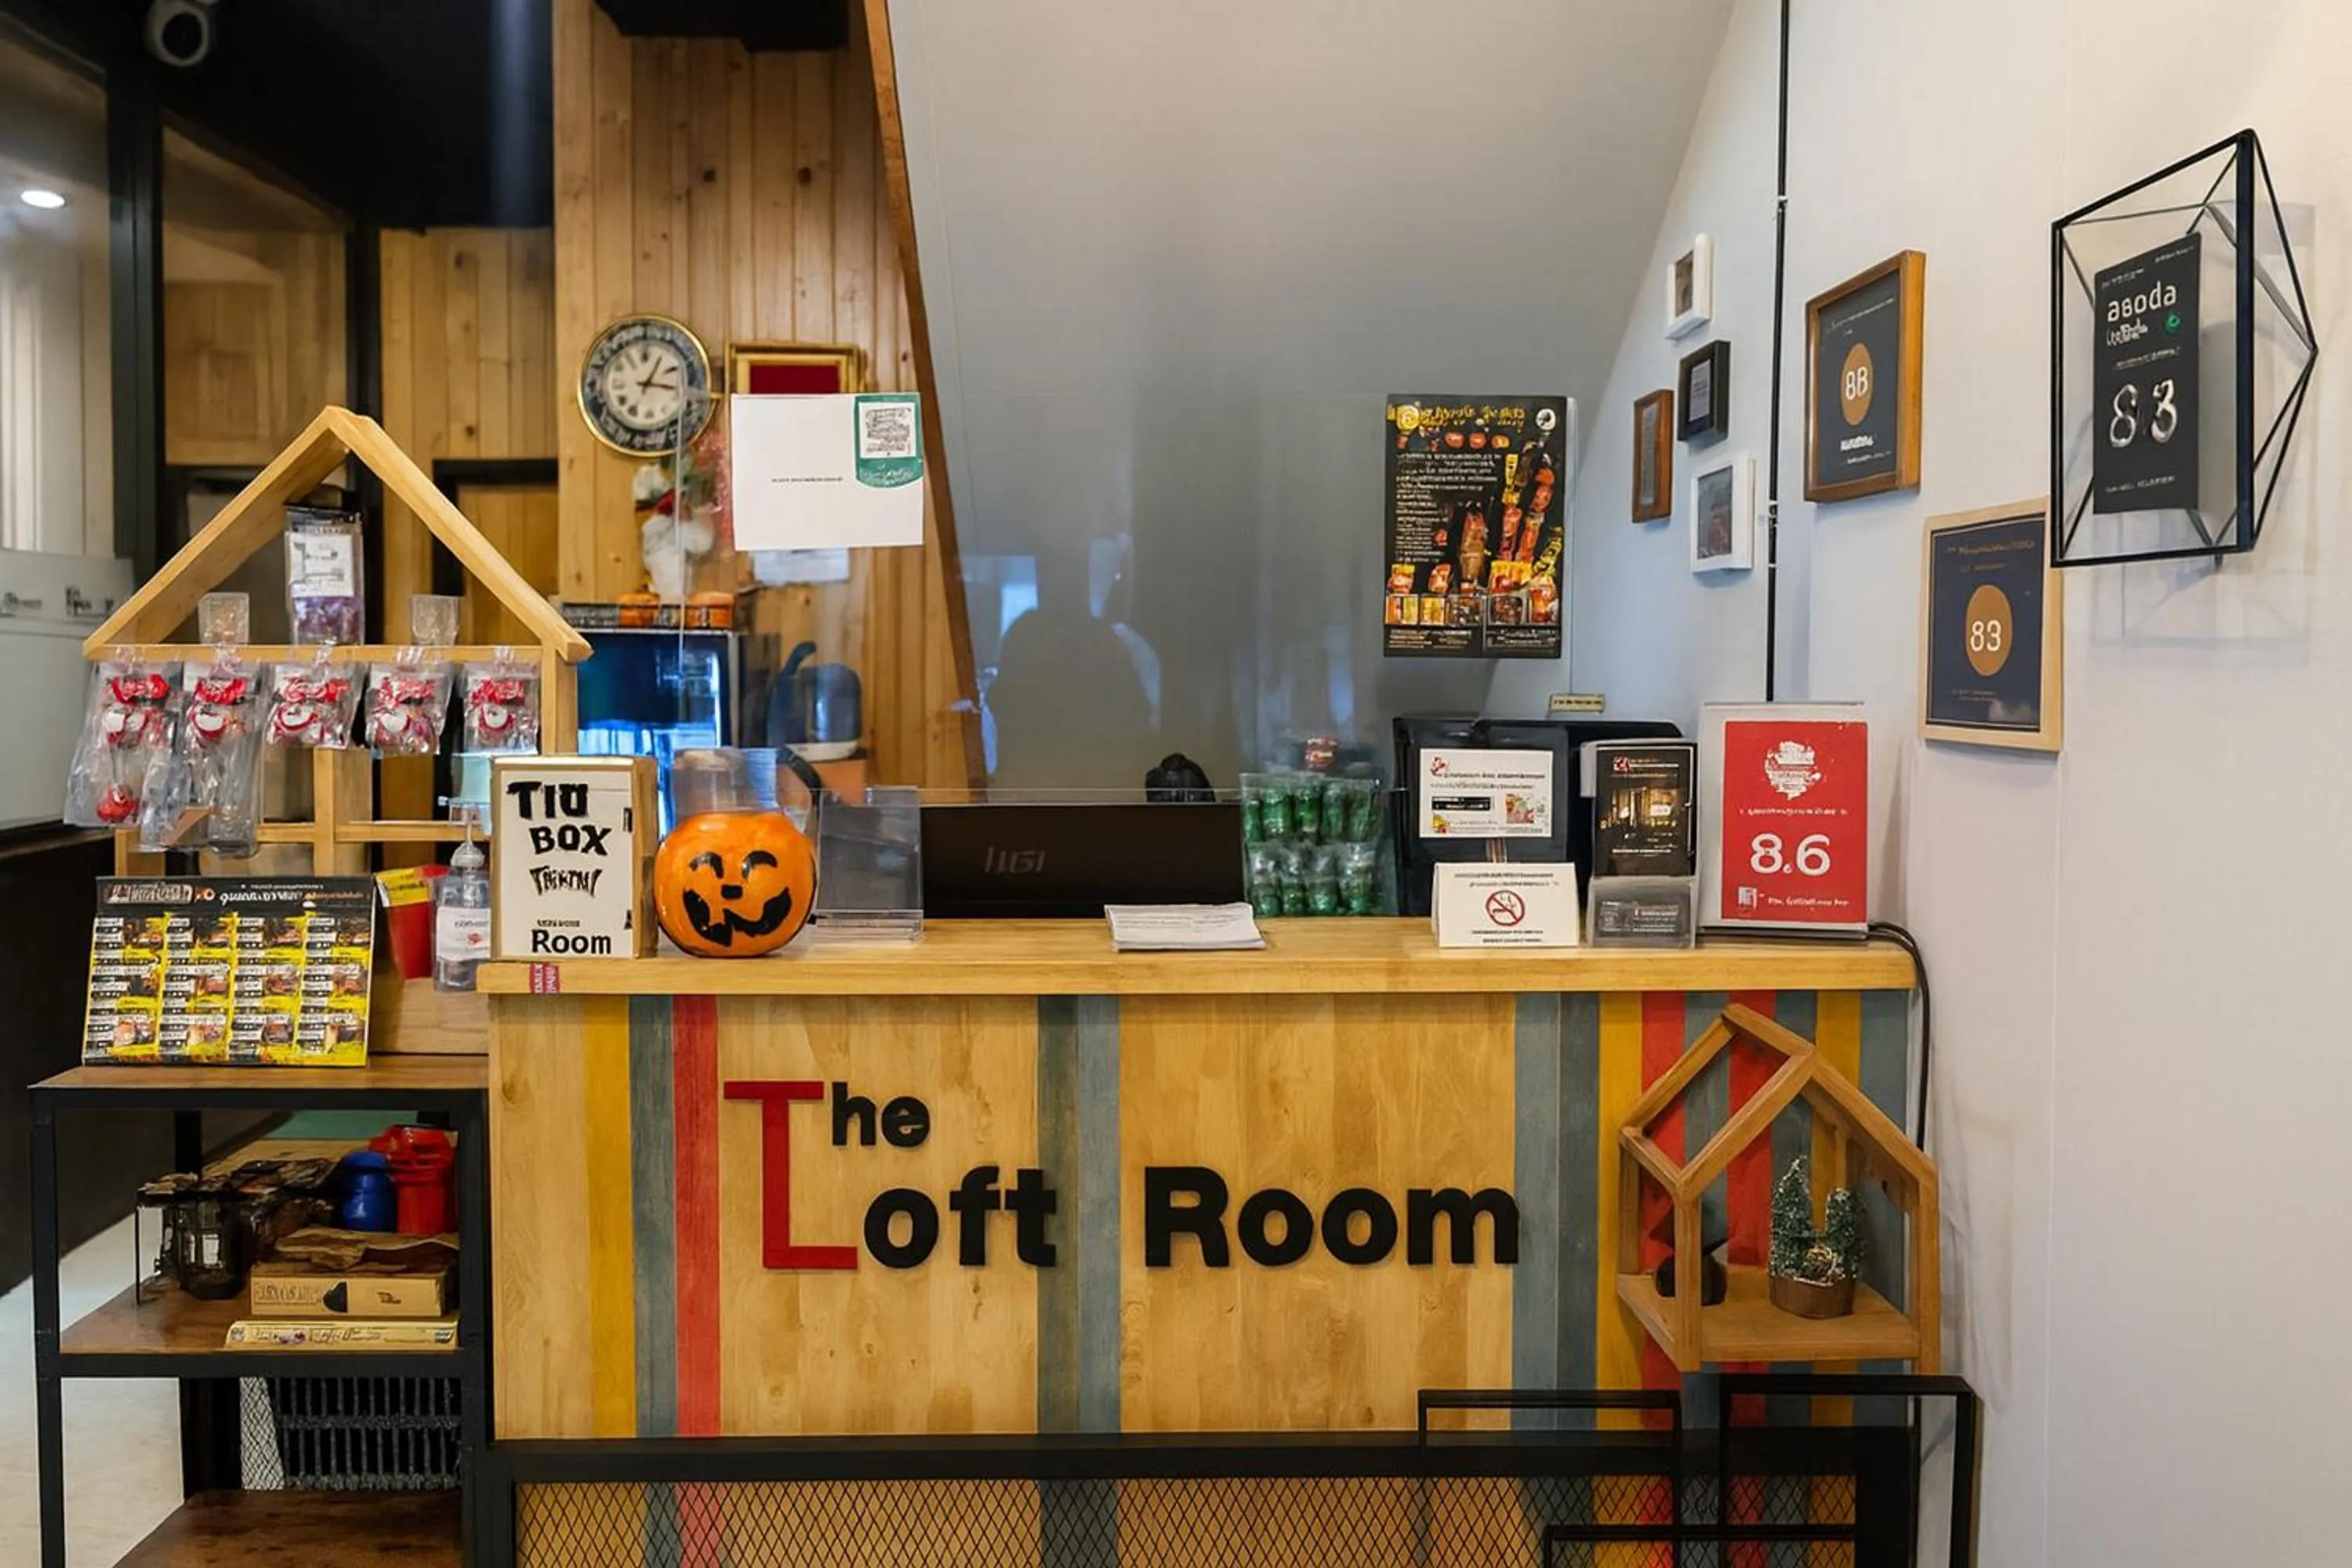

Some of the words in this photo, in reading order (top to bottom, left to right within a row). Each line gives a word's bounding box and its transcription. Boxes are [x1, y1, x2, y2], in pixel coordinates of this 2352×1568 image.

[1970, 619, 2002, 652] 83
[528, 824, 612, 856] BOX
[1750, 832, 1831, 877] 8.6
[531, 928, 612, 954] Room
[762, 1165, 1057, 1270] Loft
[1144, 1166, 1519, 1268] Room
